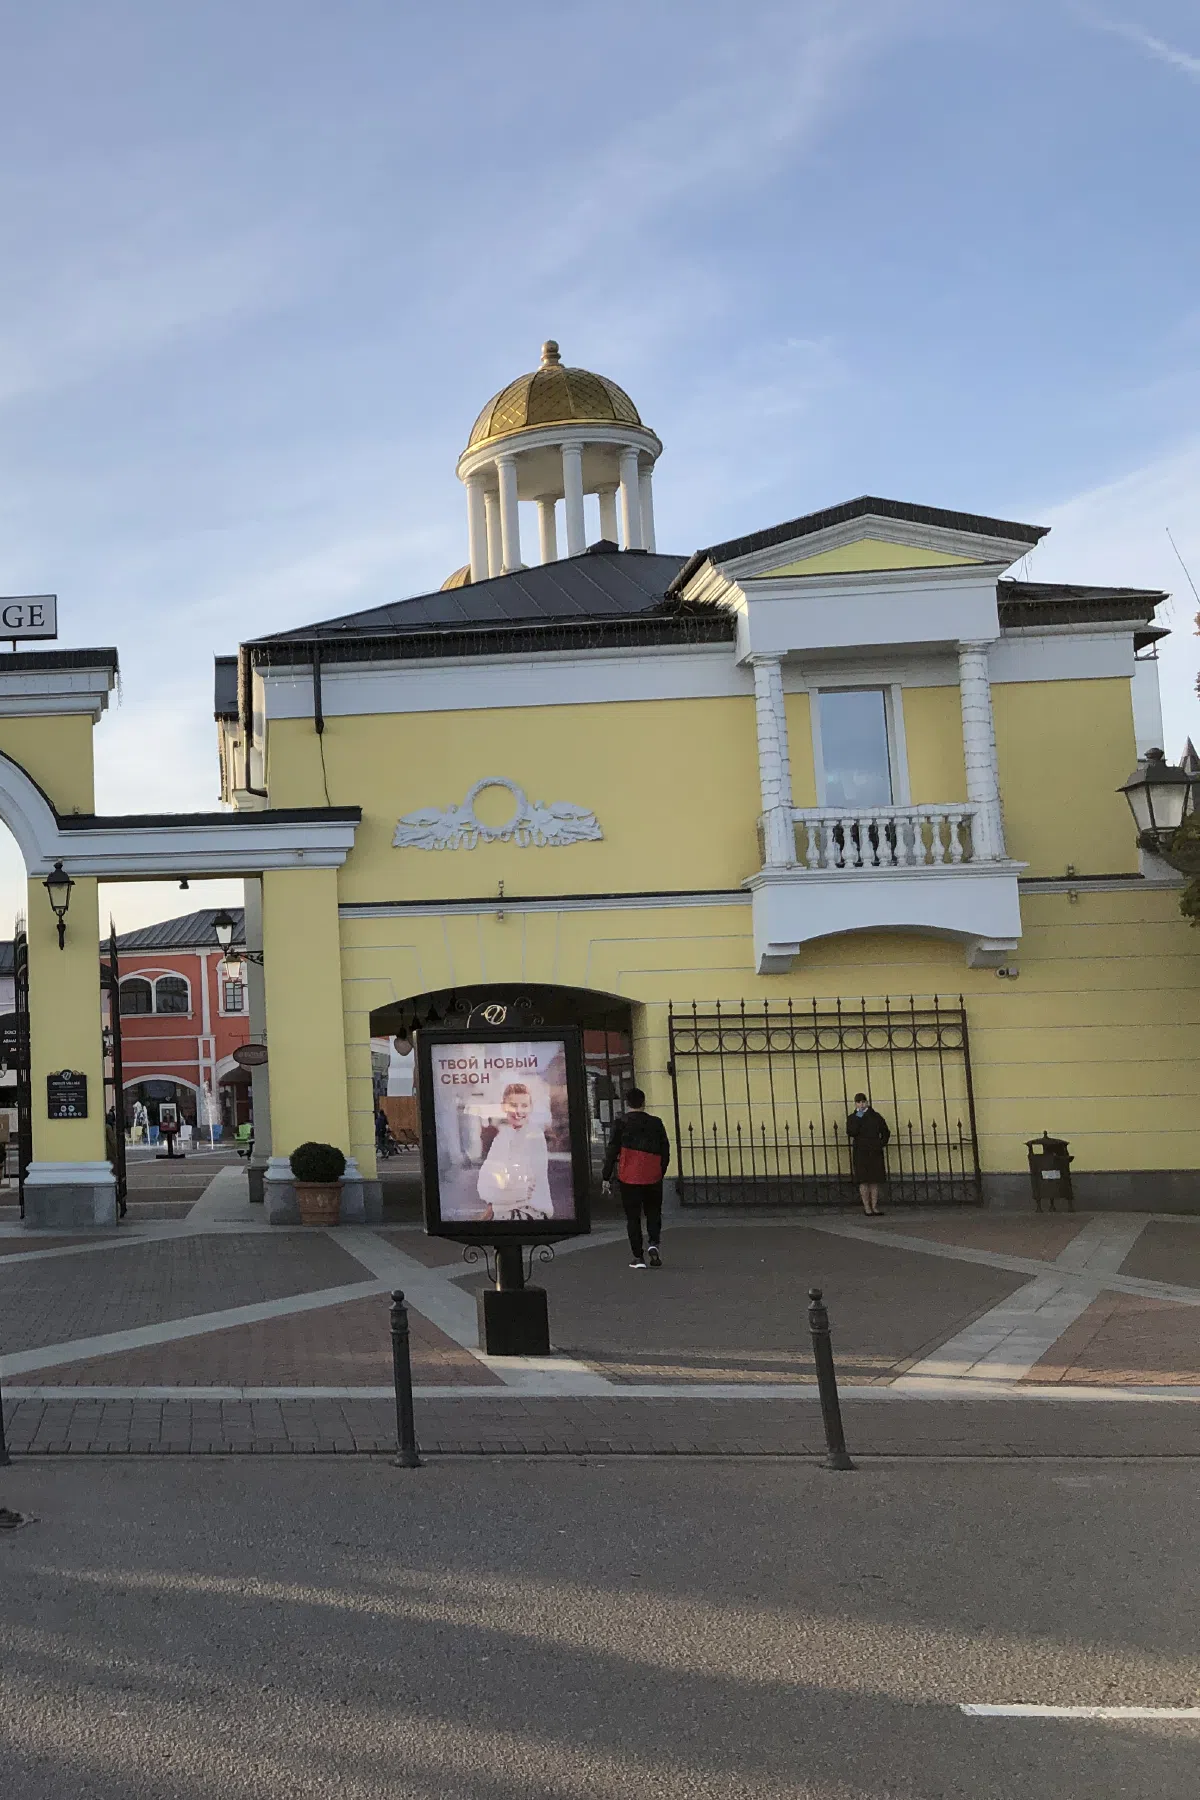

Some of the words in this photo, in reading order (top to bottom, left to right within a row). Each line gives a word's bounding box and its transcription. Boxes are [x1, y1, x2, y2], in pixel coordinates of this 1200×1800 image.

[438, 1055, 479, 1070] ТВОЙ
[483, 1054, 539, 1069] НОВЫЙ
[440, 1072, 490, 1085] СЕЗОН
